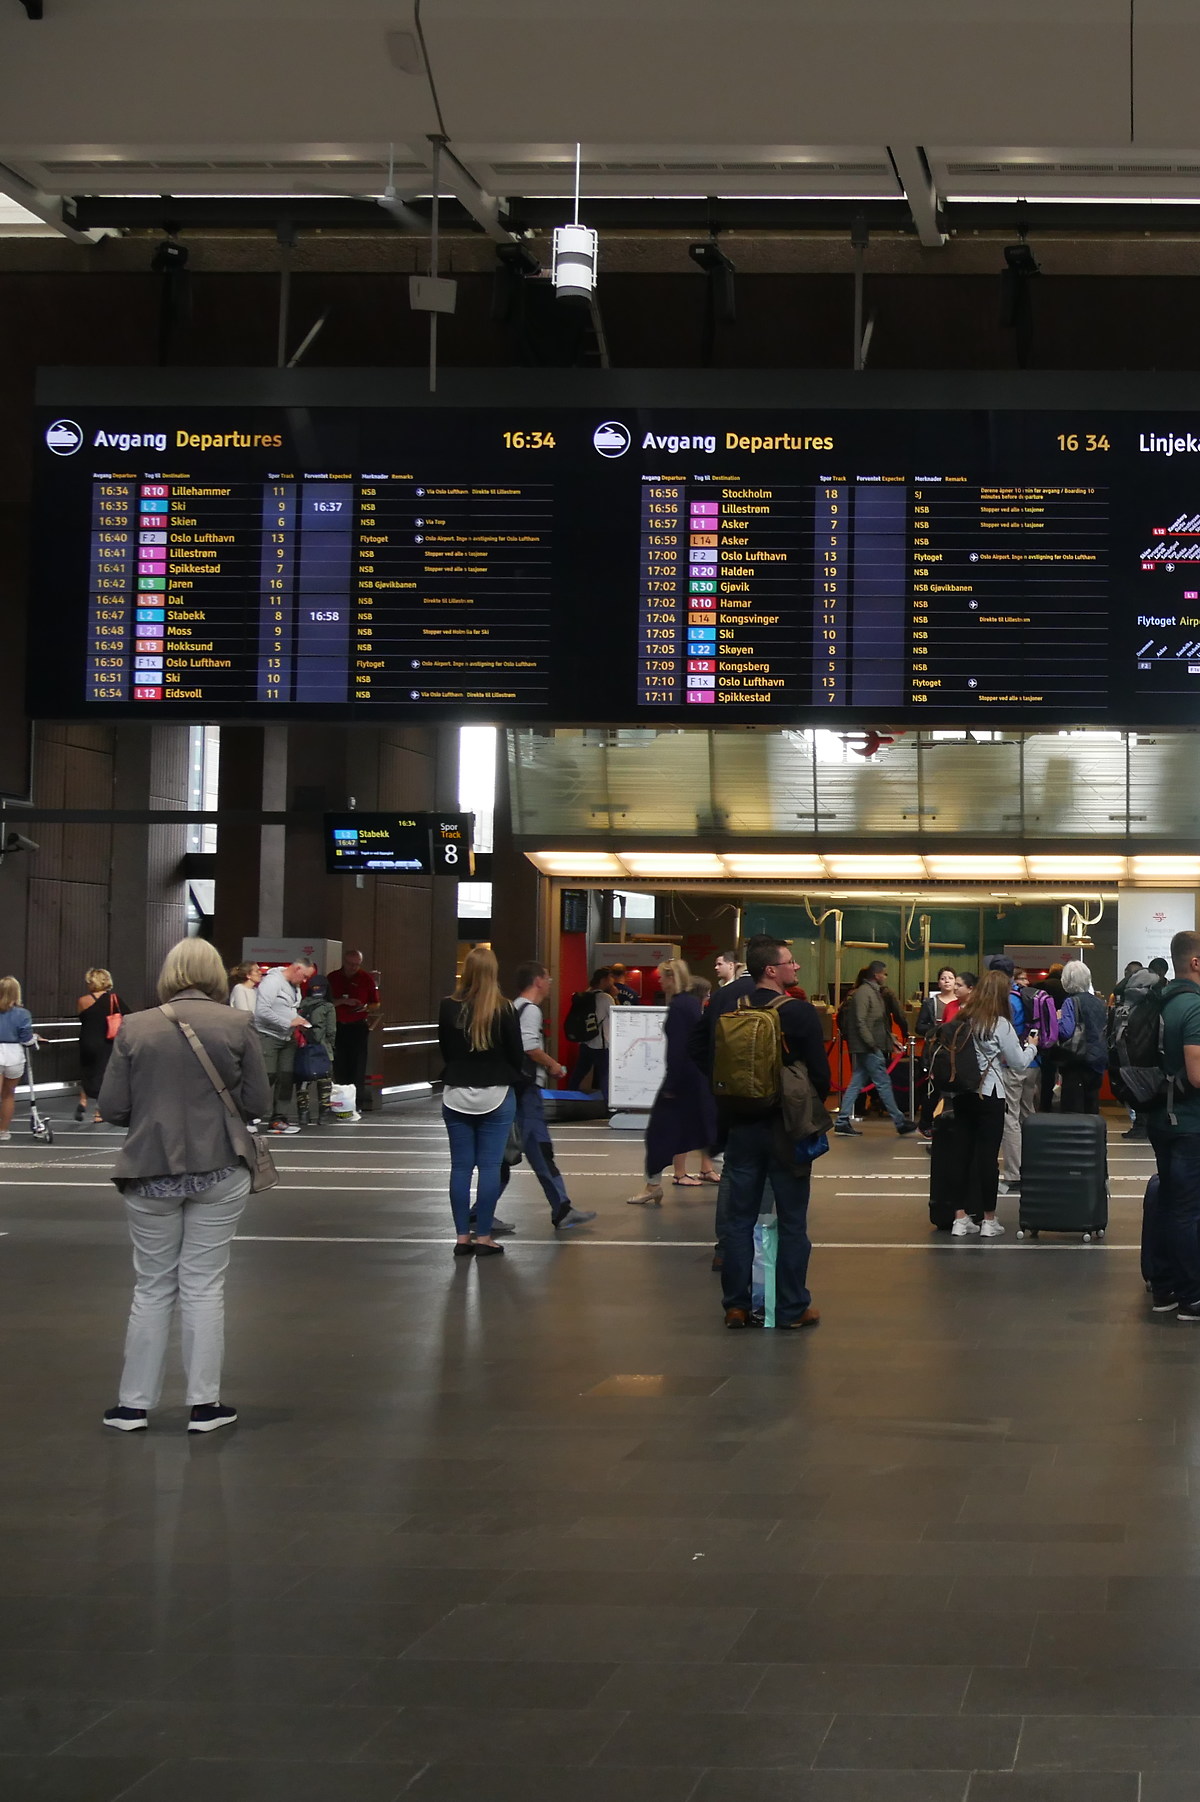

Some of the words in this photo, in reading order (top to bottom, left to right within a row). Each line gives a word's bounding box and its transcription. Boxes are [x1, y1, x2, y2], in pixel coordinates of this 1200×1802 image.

[94, 431, 166, 451] Avgang
[177, 431, 281, 451] Departures
[504, 432, 555, 448] 16:34
[642, 432, 715, 453] Avgang
[726, 433, 833, 453] Departures
[101, 487, 128, 495] 16:34
[173, 487, 231, 495] Lillehammer
[650, 489, 678, 497] 16:56
[723, 489, 771, 498] Stockholm
[100, 502, 127, 510] 16:35
[172, 502, 185, 510] Ski
[314, 502, 342, 511] 16:37
[650, 504, 677, 513] 16:56
[723, 504, 769, 513] Lillestrøm
[100, 517, 127, 525] 16:39
[171, 517, 196, 526] Skien
[649, 520, 677, 528] 16:57
[722, 520, 748, 528] Asker
[100, 534, 127, 542] 16:40
[171, 534, 191, 542] Oslo
[194, 533, 234, 542] Lufthavn
[649, 536, 677, 544] 16:59
[721, 536, 748, 545] Asker
[99, 549, 125, 557] 16:41
[170, 549, 216, 557] Lillestrøm
[649, 551, 676, 560] 17:00
[721, 551, 742, 560] Oslo
[746, 551, 786, 560] Lufthavn
[98, 564, 124, 572] 16:41
[170, 564, 220, 574] Spikkestad
[648, 567, 676, 575] 17:02
[721, 567, 754, 576] Halden
[98, 579, 125, 588] 16:42
[169, 580, 193, 590] Jaren
[648, 582, 675, 590] 17:02
[721, 582, 749, 593] Gjøvik
[97, 596, 124, 604] 16:44
[169, 596, 184, 604] Dal
[647, 599, 675, 607] 17:02
[721, 599, 751, 607] Hamar
[96, 611, 124, 619] 16:47
[168, 611, 205, 620] Stabekk
[310, 612, 339, 620] 16:58
[647, 614, 675, 622] 17:04
[720, 614, 779, 625] Kongsvinger
[1138, 616, 1176, 627] Flytoget
[96, 626, 123, 635] 16:48
[168, 627, 192, 635] Moss
[647, 630, 674, 638] 17:05
[720, 629, 734, 638] Ski
[96, 642, 123, 650] 16:49
[167, 642, 212, 650] Hokksund
[646, 645, 674, 653] 17:05
[719, 645, 753, 656] Skøyen
[95, 658, 123, 666] 16:50
[166, 658, 187, 667] Oslo
[191, 658, 231, 667] Lufthavn
[646, 662, 674, 670] 17:09
[720, 662, 769, 673] Kongsberg
[95, 673, 120, 682] 16:51
[166, 673, 180, 682] Ski
[646, 677, 674, 685] 17:10
[719, 677, 740, 686] Oslo
[744, 677, 784, 686] Lufthavn
[94, 689, 121, 697] 16:54
[166, 689, 202, 698] Eidsvoll
[646, 692, 672, 701] 17:11
[719, 692, 770, 703] Spikkestad
[441, 823, 458, 832] Spor
[441, 830, 461, 838] Track
[445, 844, 458, 863] 8
